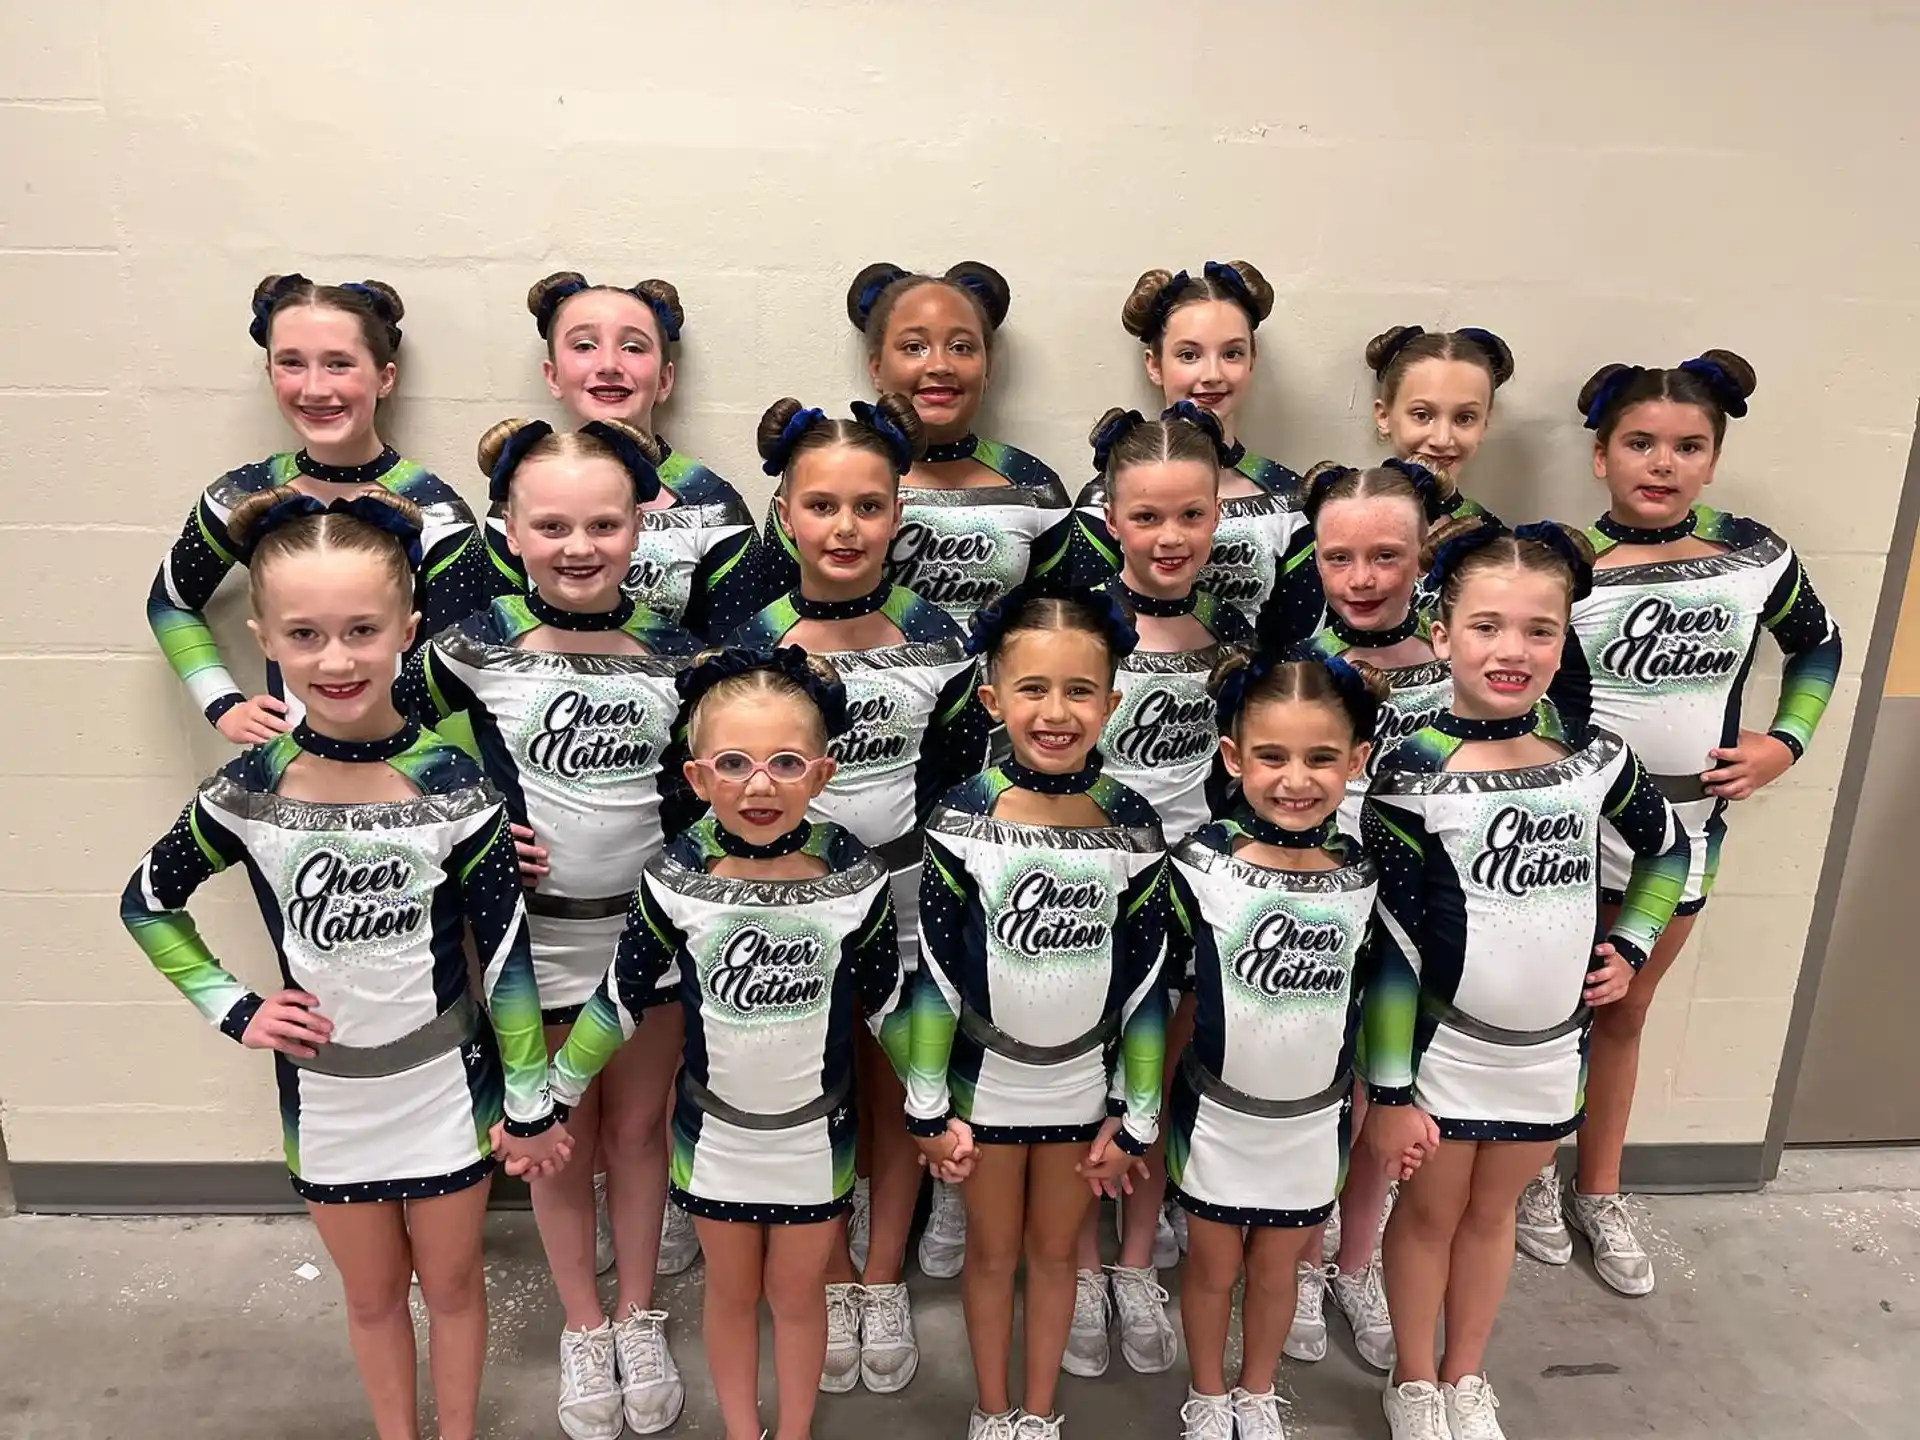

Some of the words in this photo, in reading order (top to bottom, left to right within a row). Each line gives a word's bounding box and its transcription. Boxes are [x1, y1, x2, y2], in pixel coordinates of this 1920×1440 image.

[891, 522, 994, 562] Cheer
[1212, 541, 1257, 565] eer
[1195, 570, 1264, 600] tion
[1622, 597, 1731, 640] Cheer
[1602, 635, 1738, 685] Nation
[544, 689, 646, 733] Cheer
[847, 694, 897, 722] eer
[1133, 688, 1216, 727] Cheer
[528, 727, 653, 779] Nation
[827, 730, 907, 765] ation
[1116, 725, 1213, 768] Nation
[1485, 806, 1584, 850] Cheer
[294, 851, 412, 899] Cheer
[1012, 871, 1104, 913] Cheer
[1470, 845, 1591, 897] Nation
[288, 895, 423, 951] Nation
[996, 908, 1107, 956] Nation
[1252, 912, 1345, 951] Cheer
[724, 929, 820, 969] Cheer
[709, 966, 824, 1011] Nation
[1234, 949, 1346, 996] Nation
